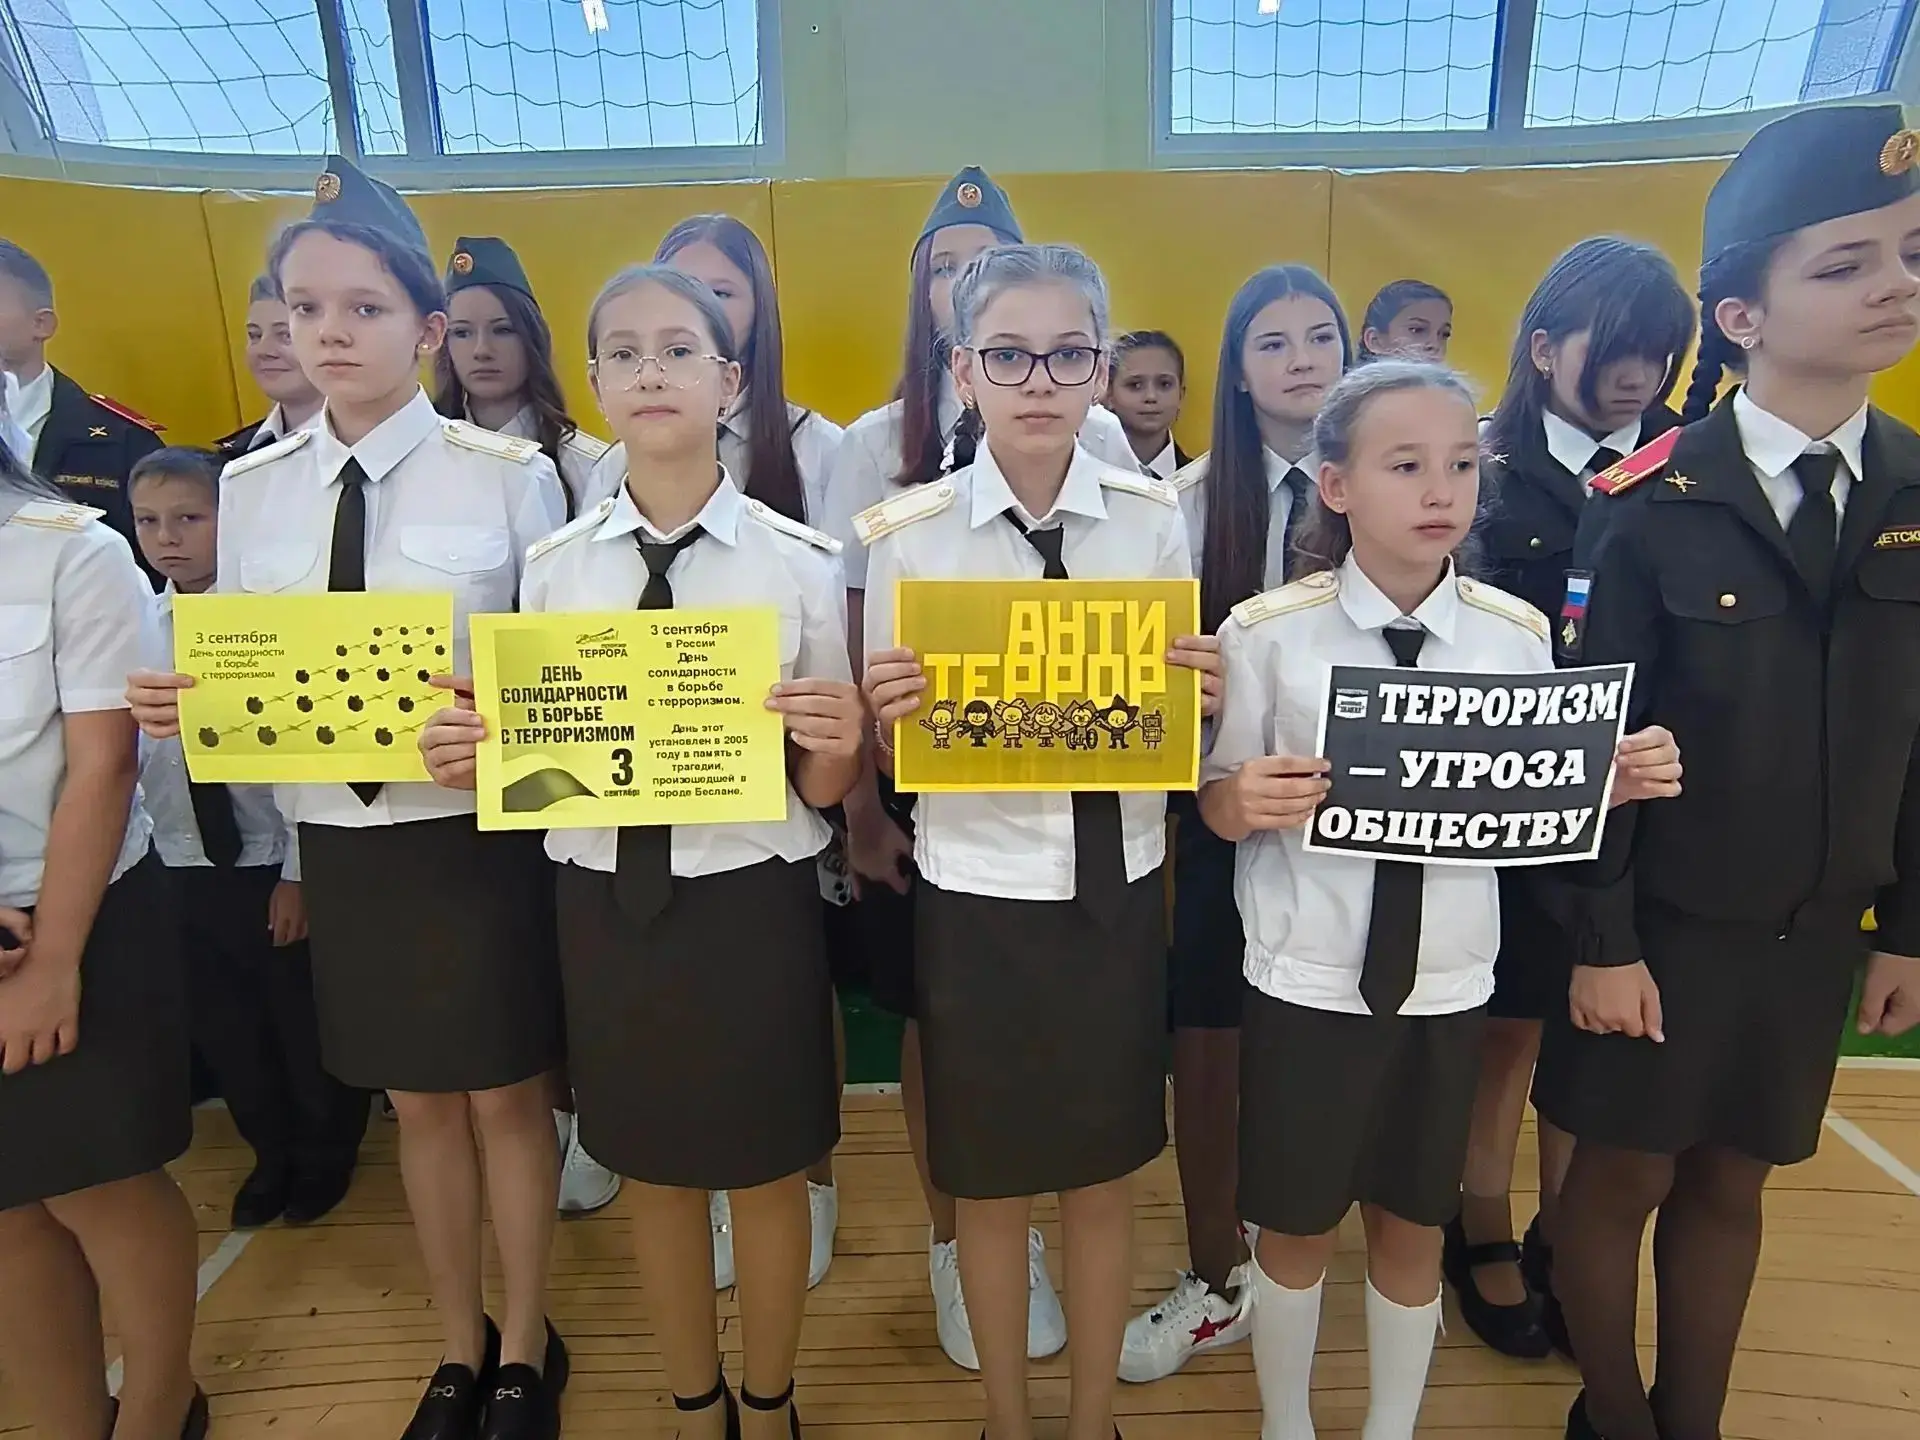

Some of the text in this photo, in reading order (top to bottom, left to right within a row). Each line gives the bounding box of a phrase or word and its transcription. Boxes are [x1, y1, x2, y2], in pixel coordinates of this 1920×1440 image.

[651, 623, 728, 636] 3 сентября
[1007, 600, 1166, 656] АНТИ
[196, 631, 277, 645] 3 сентября
[666, 639, 716, 648] в России
[189, 648, 284, 658] День солидарности
[578, 649, 628, 658] ТЕРРОРА
[677, 652, 708, 664] День
[216, 659, 259, 669] в борьбе
[209, 671, 275, 680] терроризмом
[541, 666, 582, 684] ДЕНЬ
[648, 666, 737, 679] солидарности
[667, 681, 723, 693] в борьбе
[923, 653, 1166, 708] ТЕРРОР
[501, 685, 628, 704] СОЛИДАРНОСТИ
[648, 697, 745, 707] с терроризмом.
[1378, 680, 1622, 726] ТЕРРОРИЗМ
[528, 706, 603, 723] В БОРЬБЕ
[501, 725, 635, 745] С ТЕРРОРИЗМОМ
[672, 724, 724, 734] День этот
[649, 737, 711, 748] установлен
[724, 735, 748, 744] 2005
[656, 751, 681, 760] году
[693, 750, 731, 758] память
[611, 748, 633, 786] 3
[672, 763, 724, 772] трагедии,
[1400, 749, 1586, 789] УГРОЗА
[652, 775, 735, 786] произошедшей
[654, 787, 742, 798] городе Беслане.
[1317, 806, 1593, 854] ОБЩЕСТВУ
